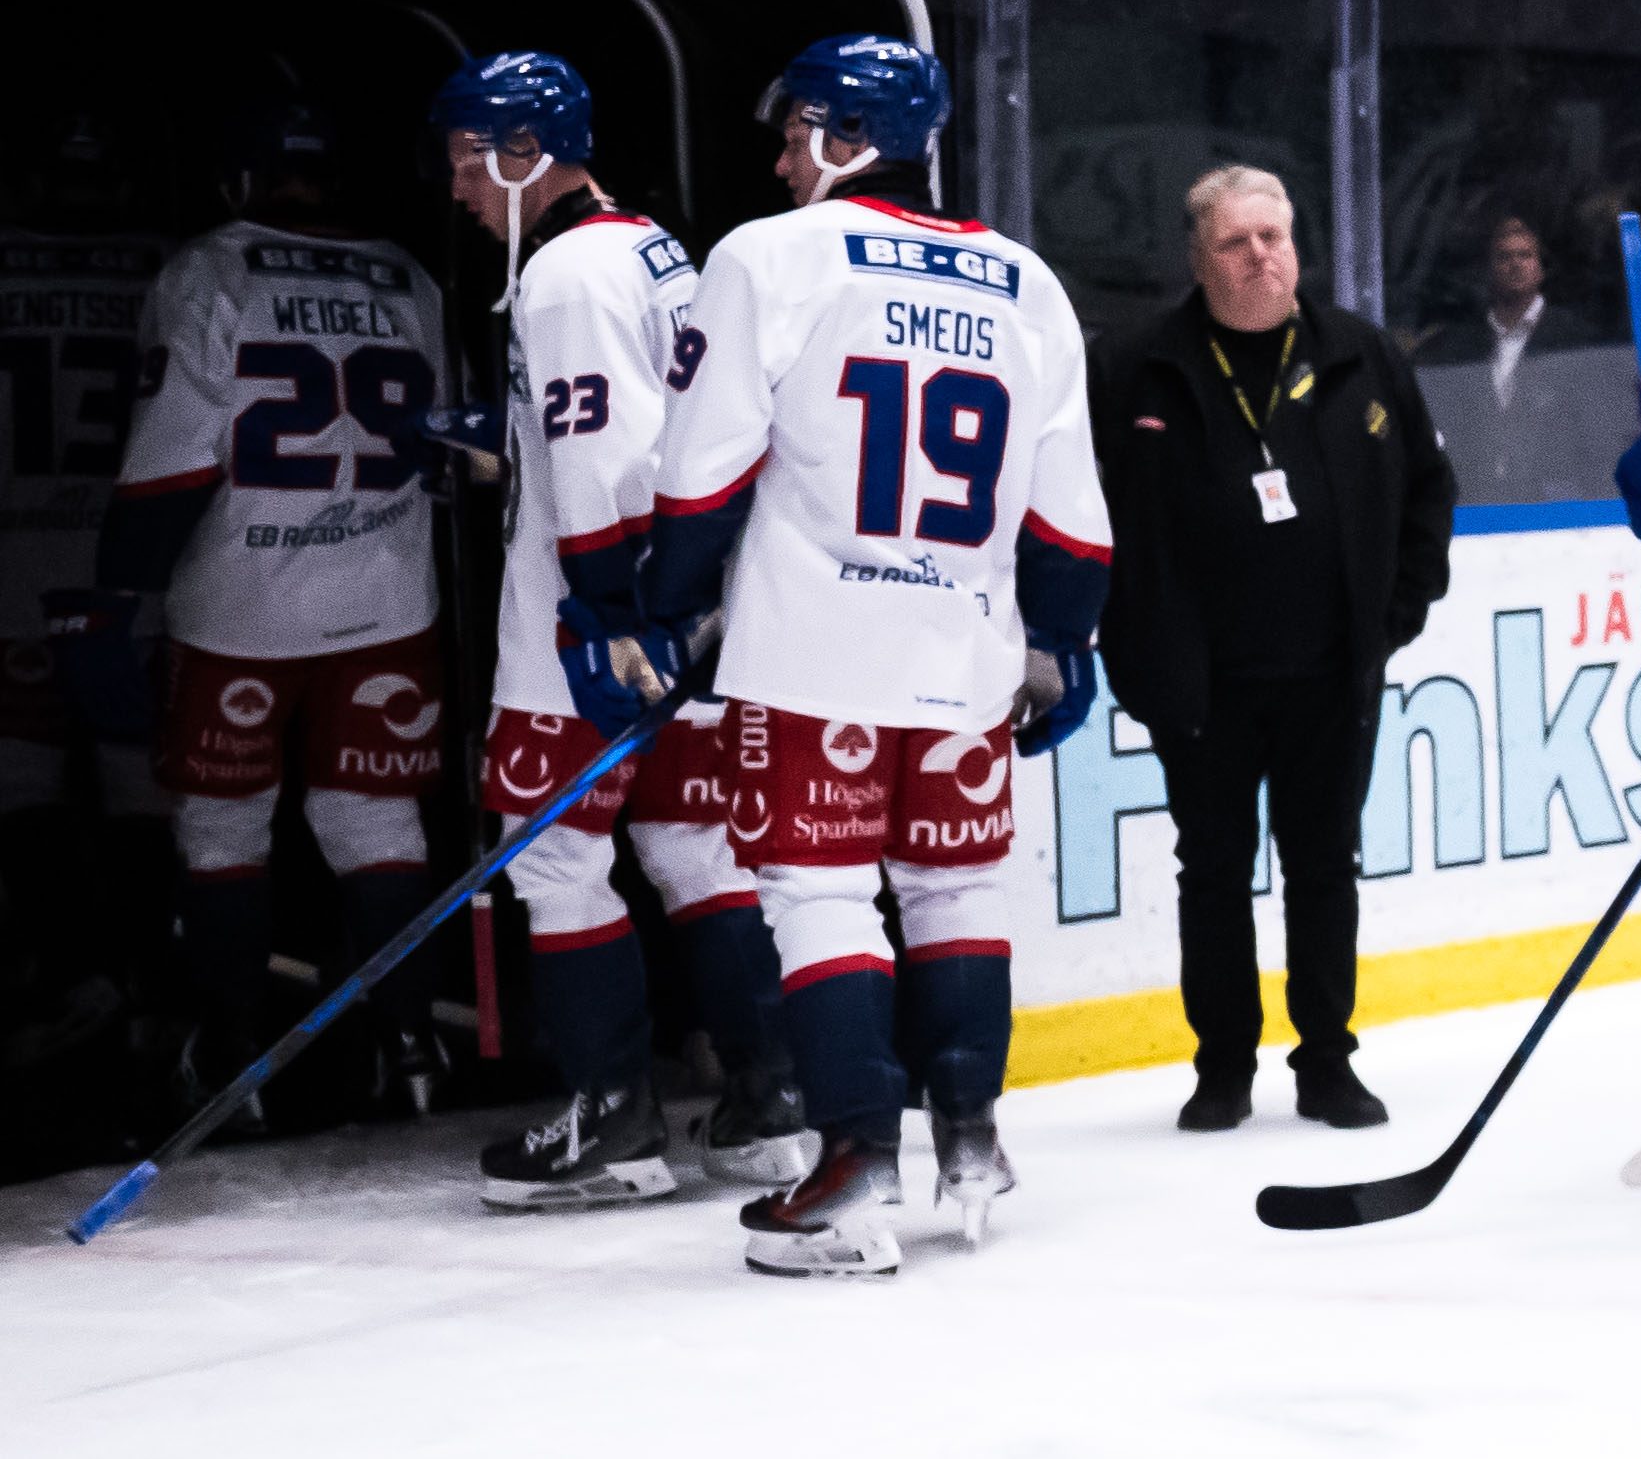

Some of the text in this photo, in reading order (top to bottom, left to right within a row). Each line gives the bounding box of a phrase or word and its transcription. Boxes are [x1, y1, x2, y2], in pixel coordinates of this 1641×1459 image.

[863, 237, 1011, 289] BE-GE
[885, 301, 995, 361] SMEDS
[231, 340, 437, 493] 29
[543, 372, 610, 442] 23
[836, 354, 1012, 549] 19
